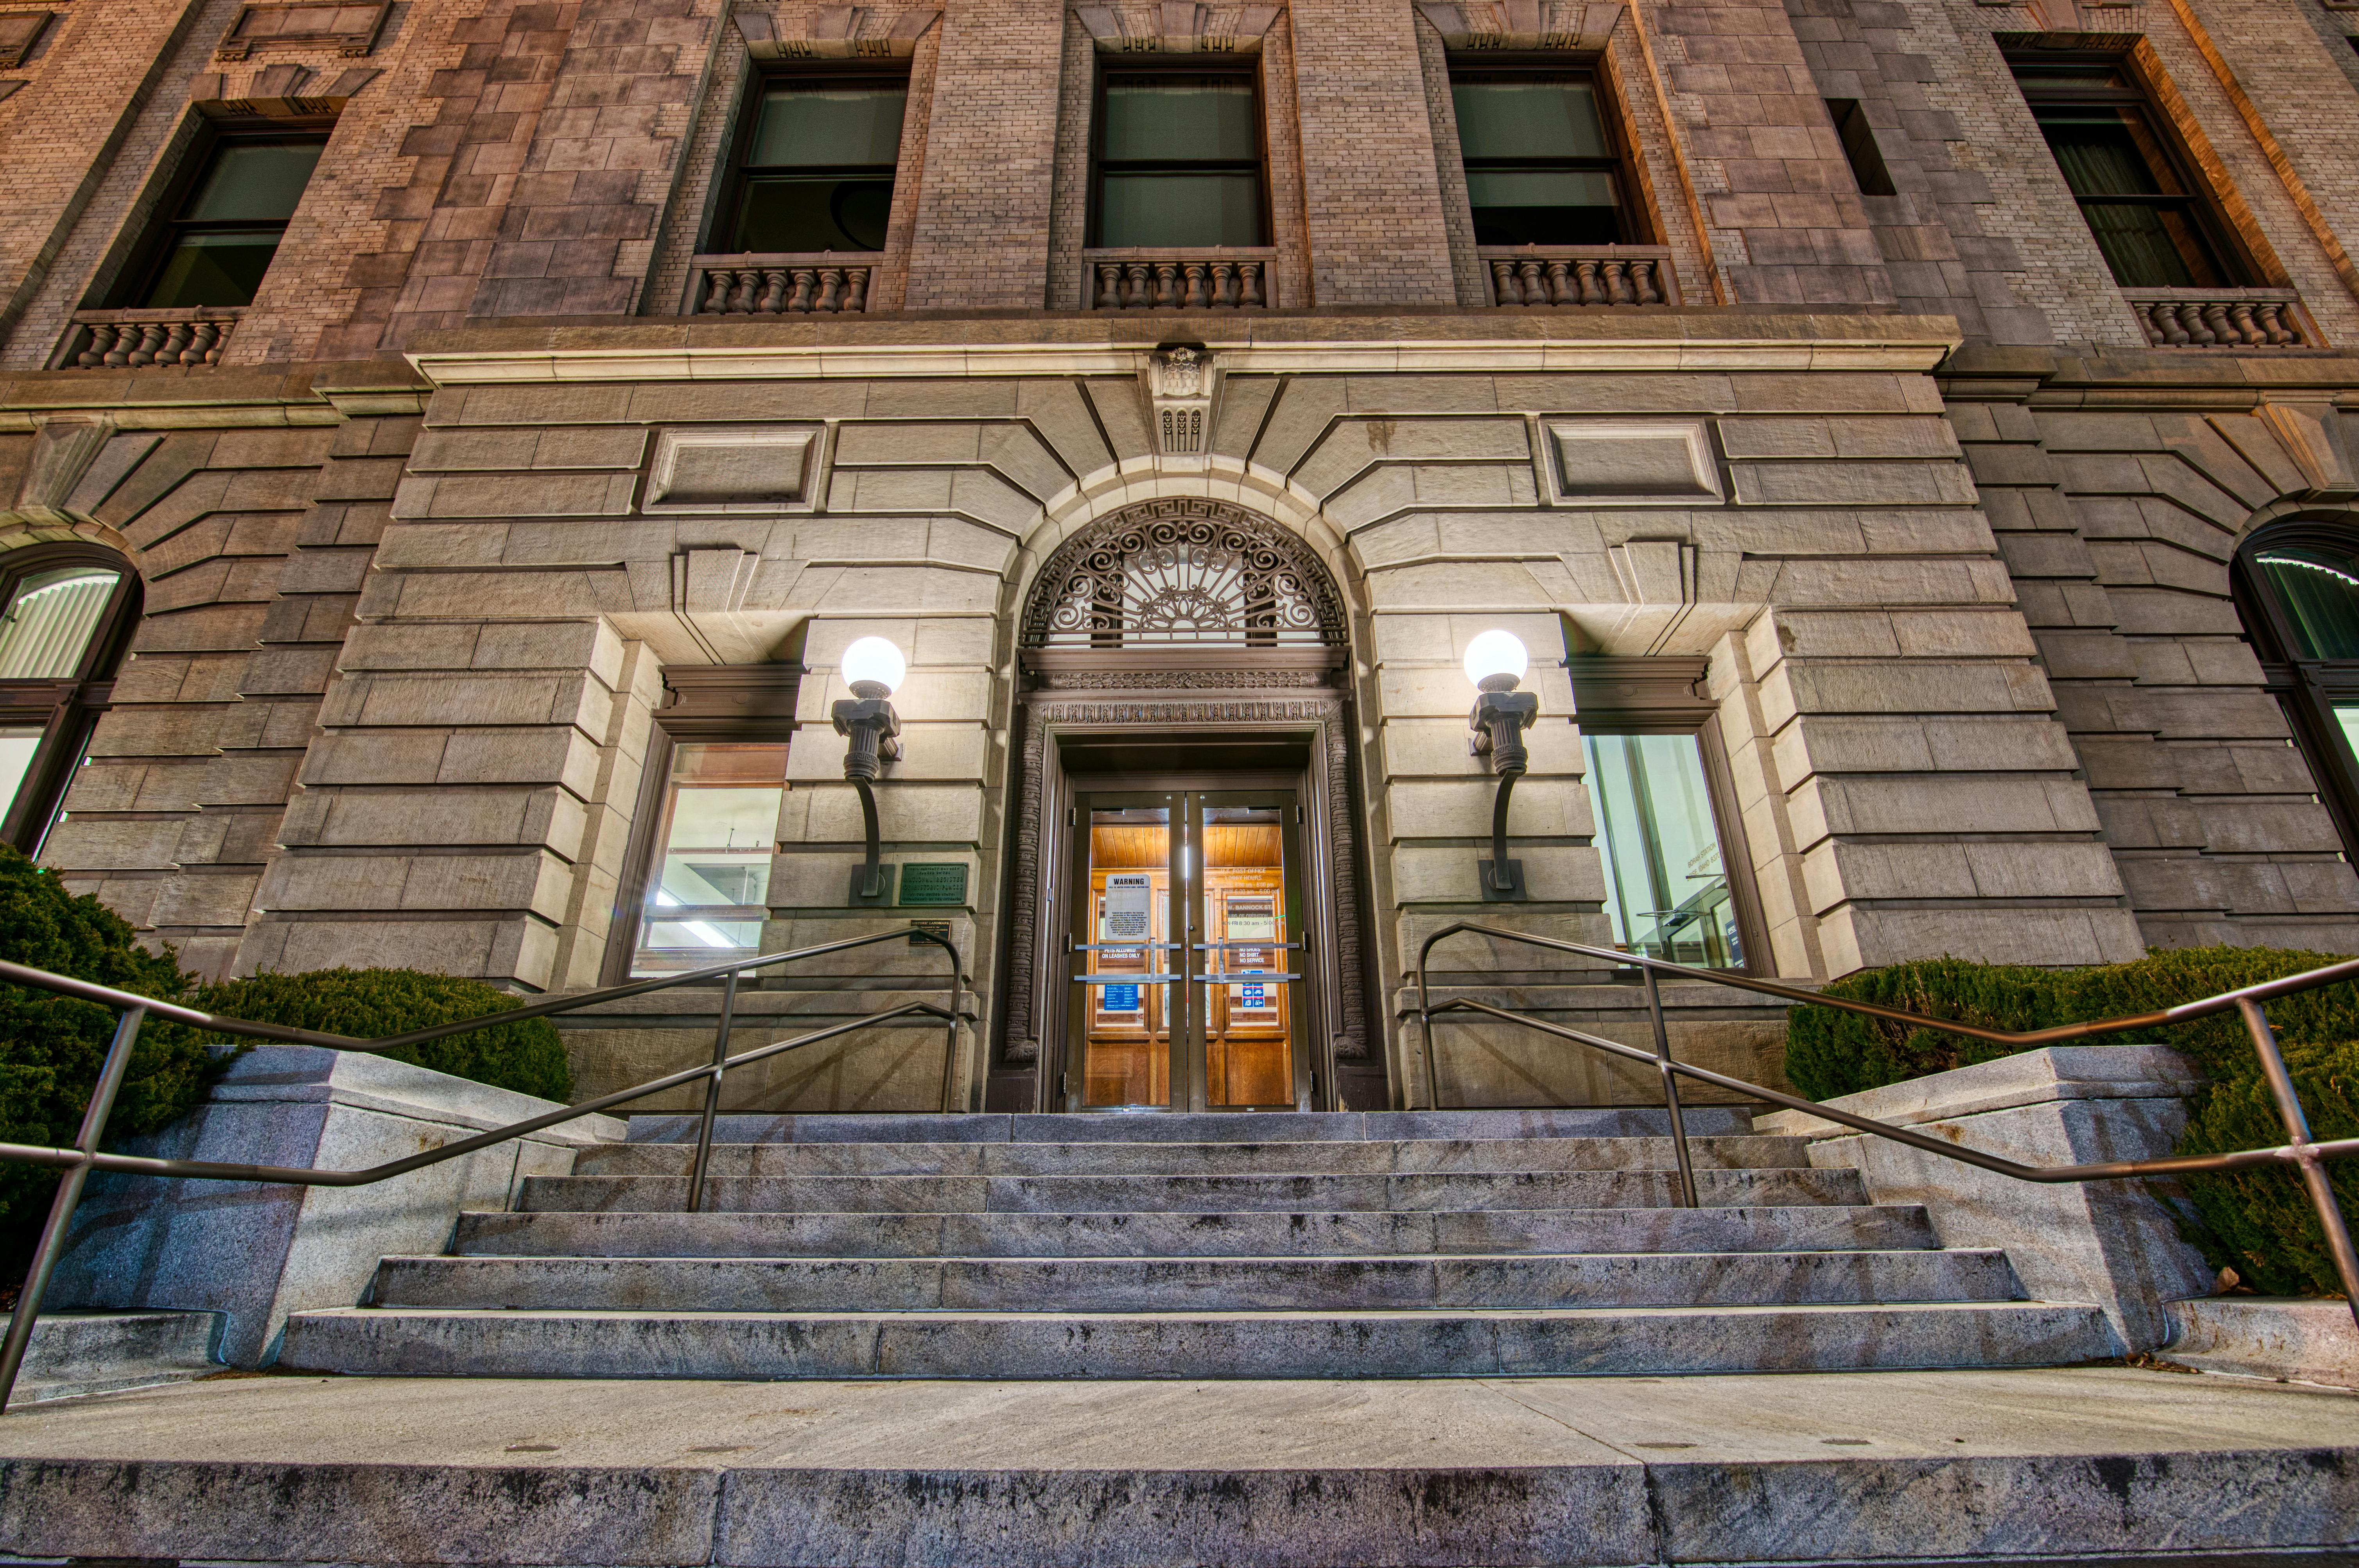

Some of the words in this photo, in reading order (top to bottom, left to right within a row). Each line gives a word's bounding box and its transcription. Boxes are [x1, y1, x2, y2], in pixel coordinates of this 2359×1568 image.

[1688, 854, 1701, 868] BORAH
[1701, 841, 1716, 858] STATION
[1698, 860, 1710, 873] IDAHO
